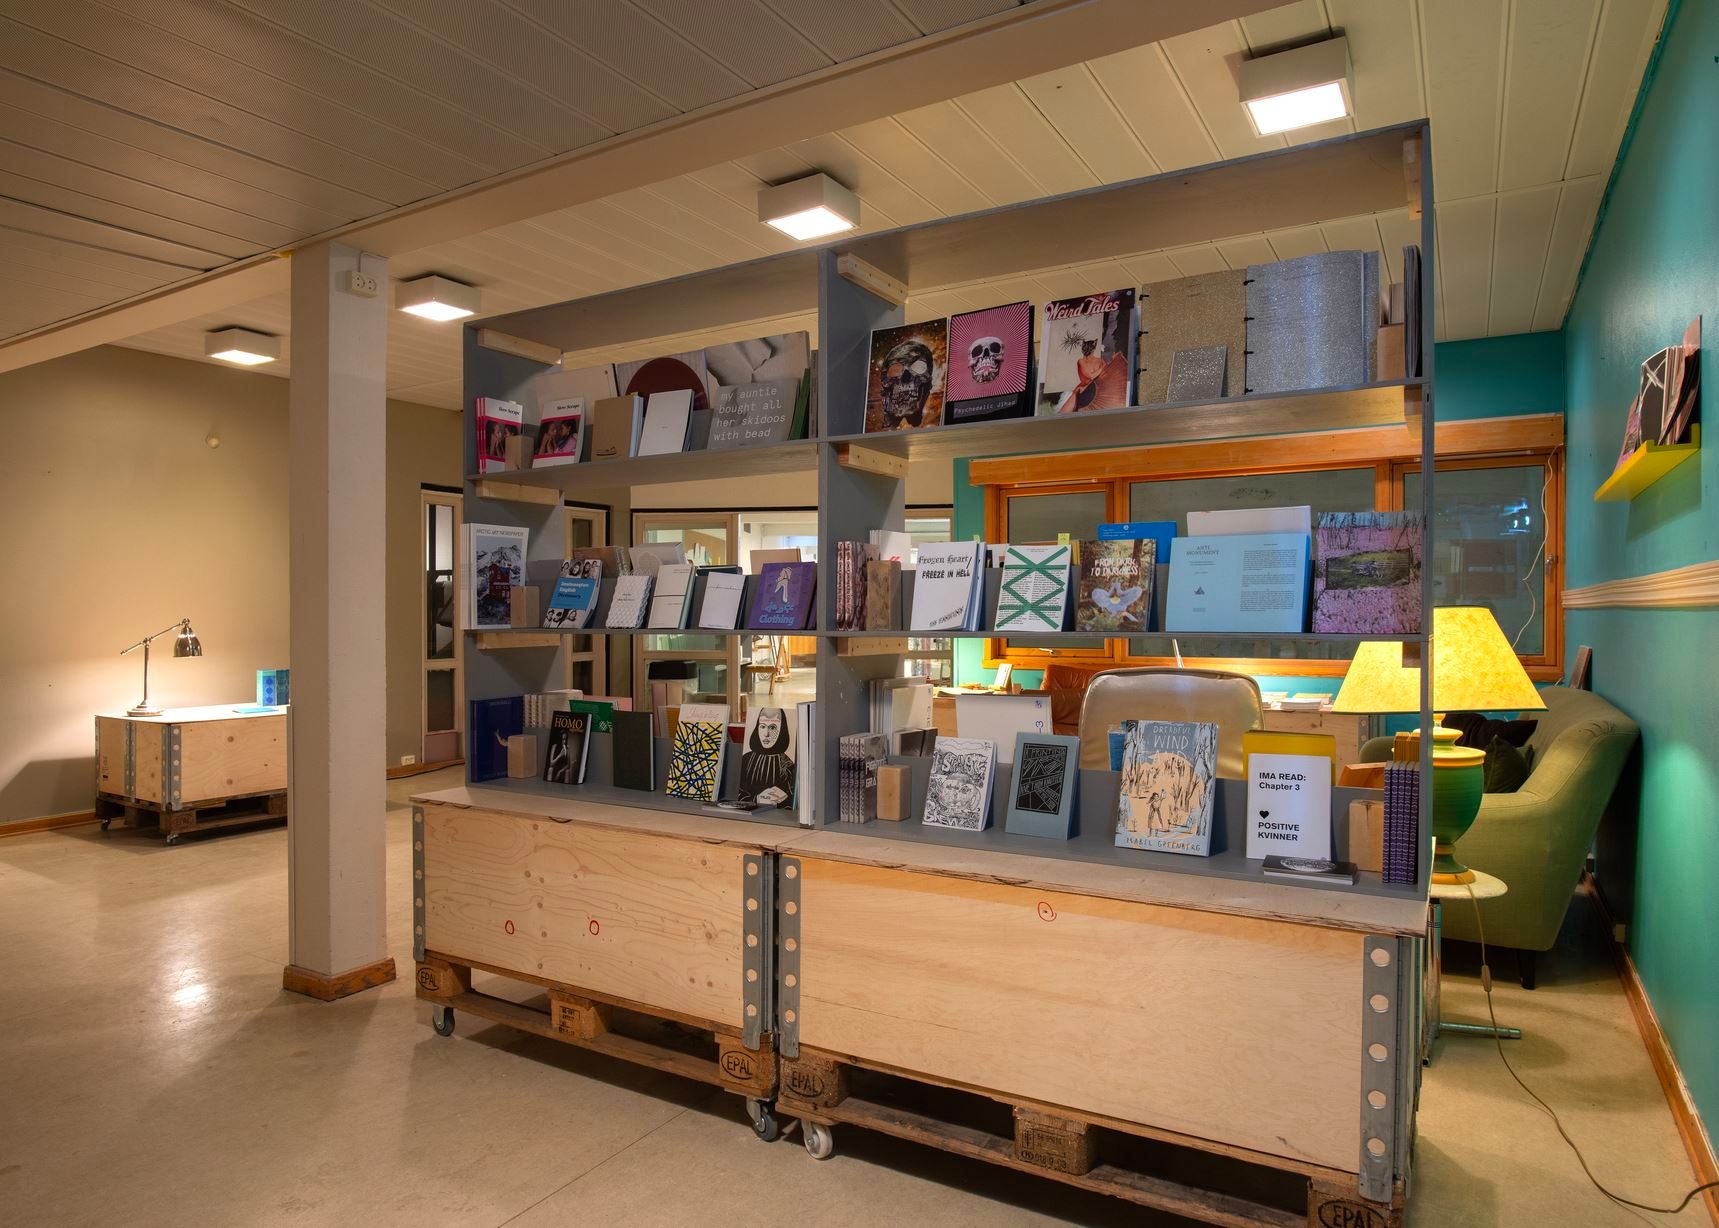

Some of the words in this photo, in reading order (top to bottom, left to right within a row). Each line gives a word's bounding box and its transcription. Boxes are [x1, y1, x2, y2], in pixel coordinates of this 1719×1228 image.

[1045, 302, 1084, 321] Weird
[1084, 296, 1120, 315] Tales
[721, 391, 734, 400] my
[740, 387, 777, 399] auntie
[719, 403, 757, 415] bought
[763, 400, 782, 410] all
[954, 404, 993, 415] Psychedelic
[716, 419, 735, 428] her
[742, 414, 786, 426] skidoos
[713, 431, 739, 441] with
[745, 428, 771, 439] bead
[918, 555, 945, 564] Frozen
[1094, 558, 1114, 567] FROM
[922, 569, 945, 579] FREEZE
[947, 570, 954, 578] IN
[956, 569, 971, 578] HELL
[1091, 567, 1101, 576] TO
[759, 614, 795, 626] Clothing
[554, 717, 583, 729] HOMO
[1153, 725, 1192, 735] DREADFUL
[1154, 735, 1189, 749] WIND
[1259, 772, 1276, 780] IMA
[1278, 773, 1306, 781] READ:
[1259, 782, 1293, 791] Chapter
[1258, 822, 1300, 831] POSITIVE
[1258, 831, 1298, 841] KVINNER
[1126, 837, 1152, 847] ISABEL
[1157, 838, 1201, 851] GREENBERG
[420, 971, 438, 987] EPAL
[726, 1055, 752, 1075] EPAL
[791, 1070, 819, 1092] EPAL
